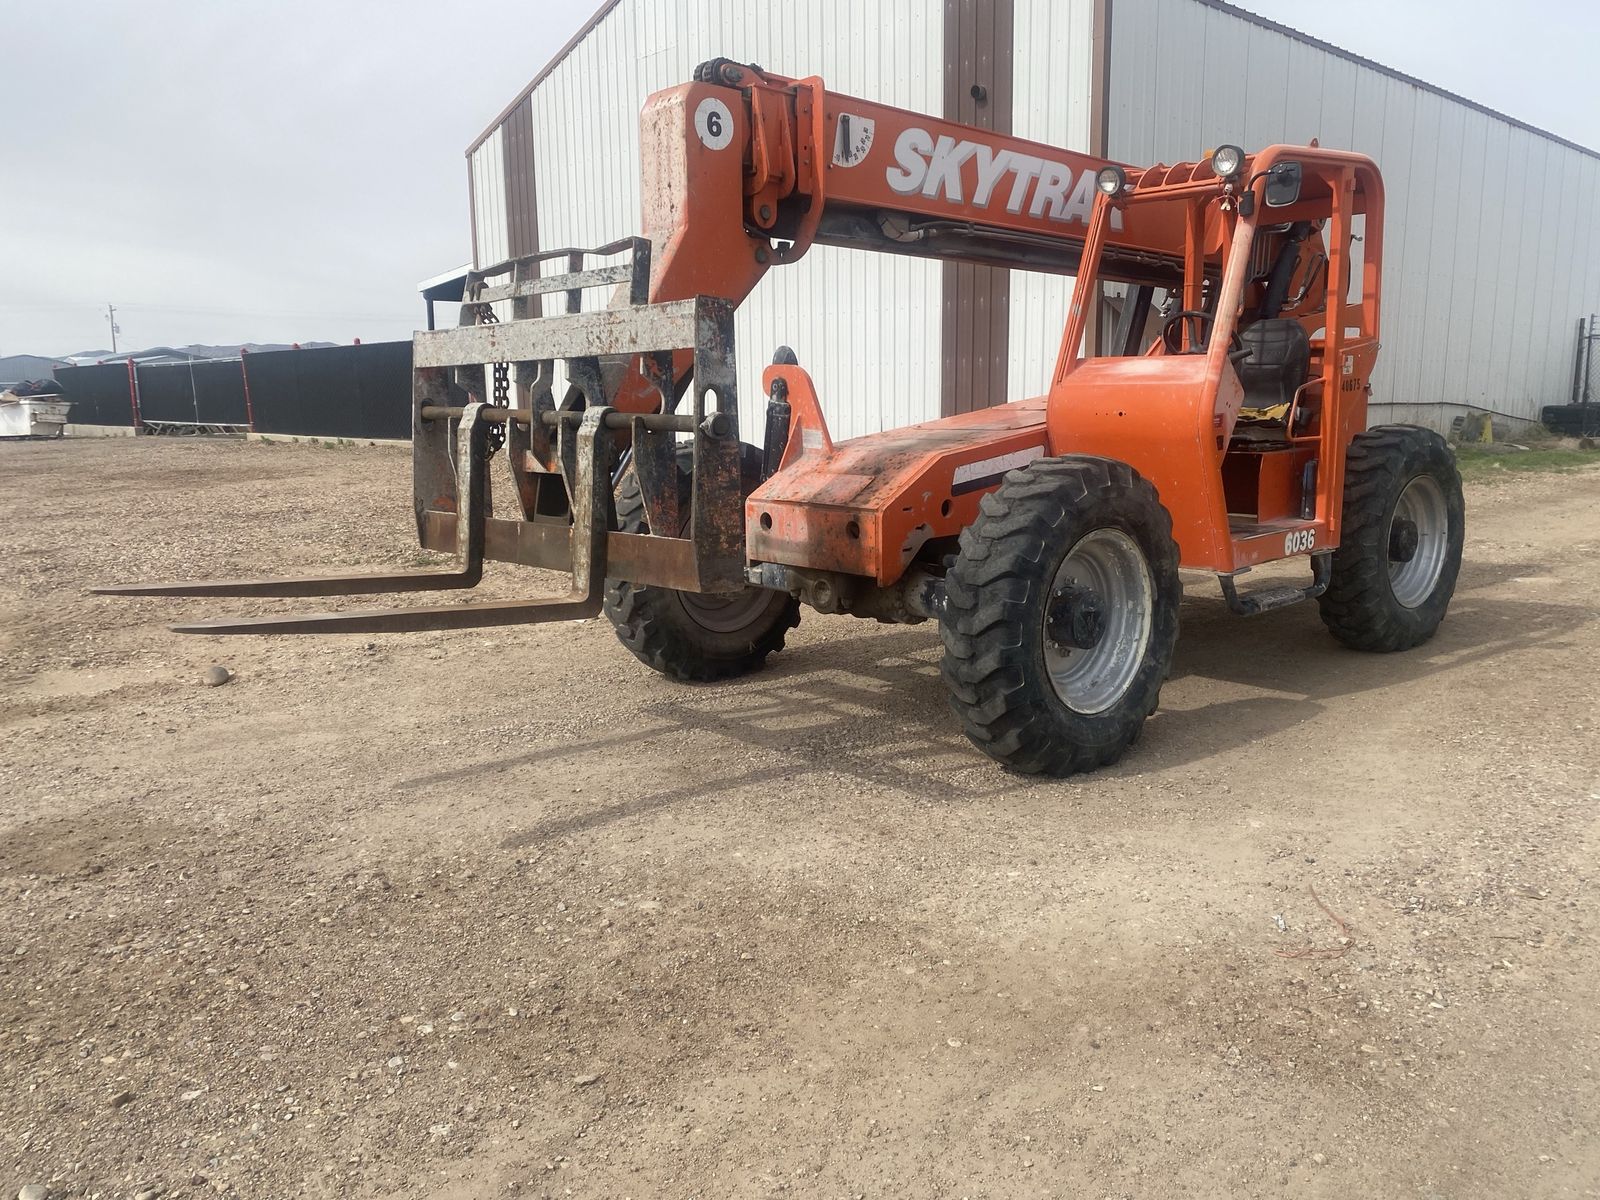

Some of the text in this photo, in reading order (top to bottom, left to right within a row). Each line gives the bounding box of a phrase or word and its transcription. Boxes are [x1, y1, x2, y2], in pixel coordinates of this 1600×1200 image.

[707, 111, 722, 137] 6
[886, 127, 1126, 232] SKYTRA
[1284, 528, 1316, 556] 6036
